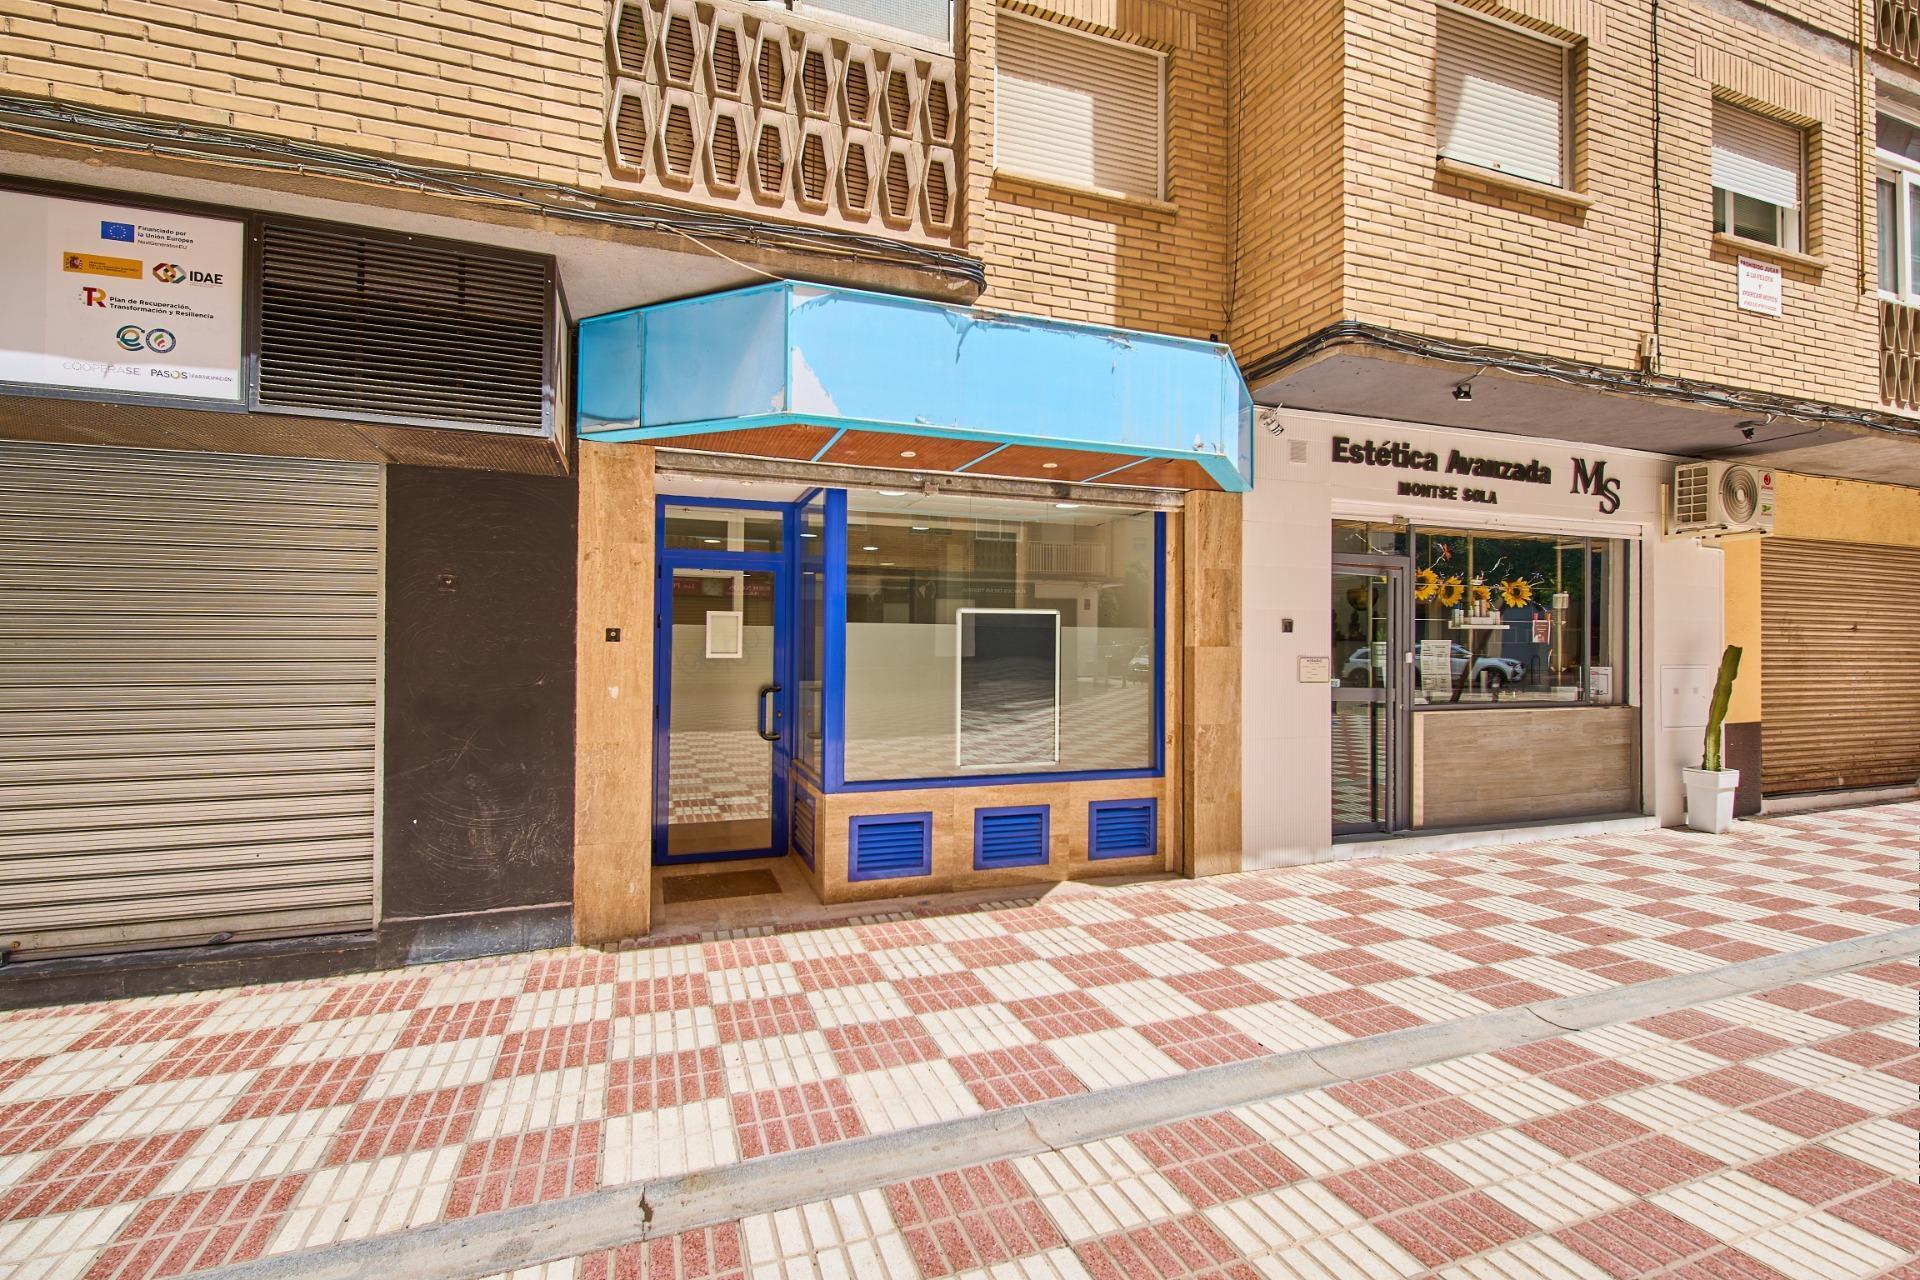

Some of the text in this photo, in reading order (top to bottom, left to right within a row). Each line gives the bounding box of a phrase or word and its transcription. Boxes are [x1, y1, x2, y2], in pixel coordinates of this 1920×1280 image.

[138, 225, 174, 235] Financiado
[145, 232, 165, 240] Unión
[166, 235, 194, 244] Europea
[1740, 260, 1779, 274] PROHIBIDO JUGAR
[189, 270, 223, 285] IDAE
[109, 303, 168, 314] Transformación
[175, 310, 214, 319] Resiliencia
[139, 299, 192, 310] Recuperación,
[150, 368, 188, 380] PASOS
[1332, 436, 1552, 485] Estética Avanzada
[1397, 481, 1498, 505] MONTSE SOLA
